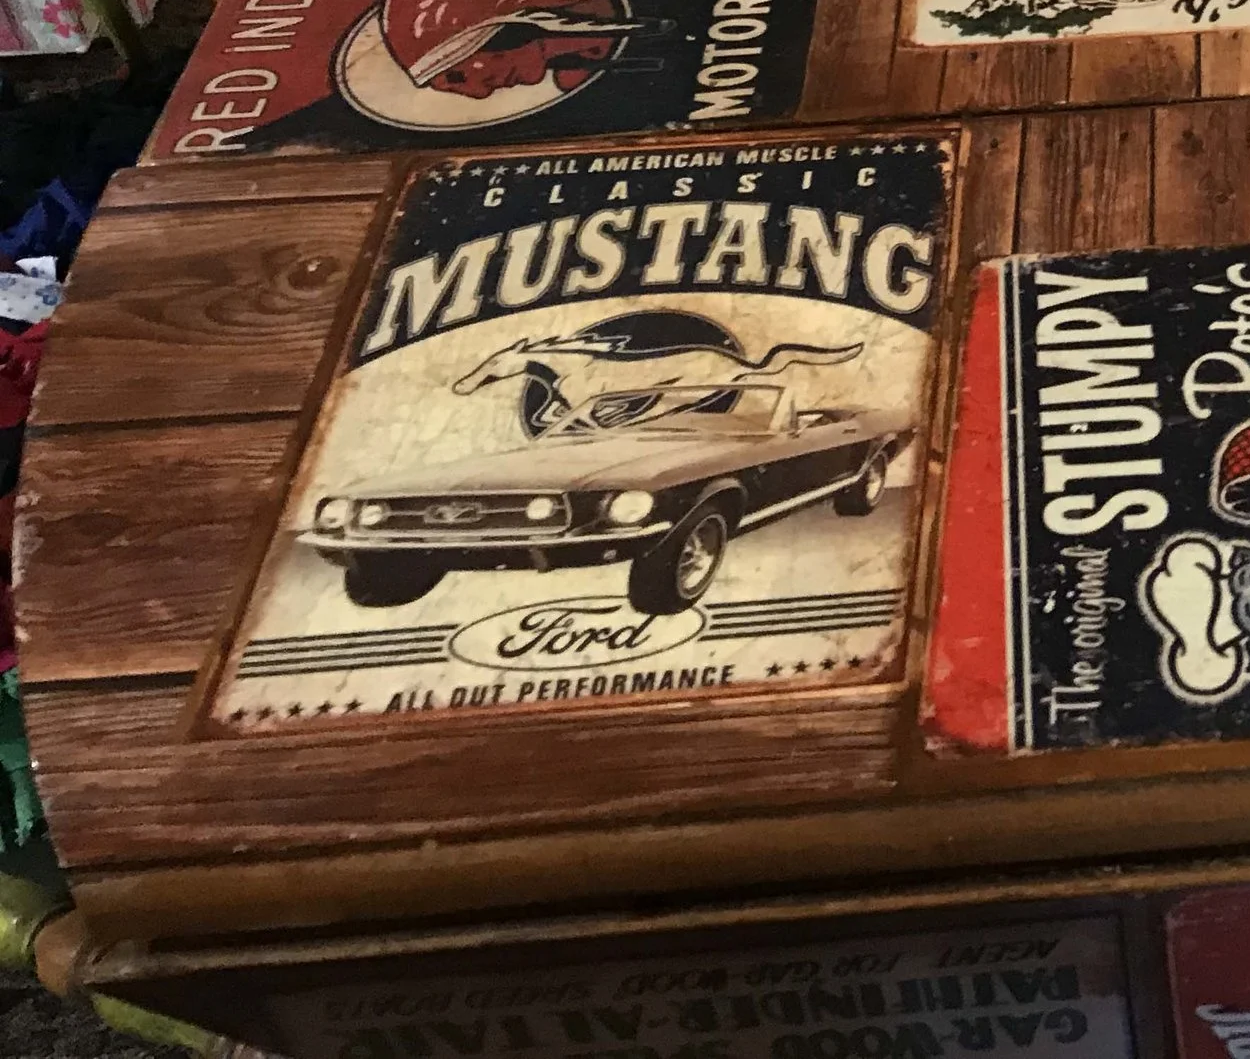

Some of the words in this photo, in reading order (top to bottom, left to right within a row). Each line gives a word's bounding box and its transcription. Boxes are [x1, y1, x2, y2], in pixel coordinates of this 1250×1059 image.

[174, 68, 281, 154] RED
[483, 165, 877, 208] CLASSIC
[536, 156, 580, 177] ALL
[588, 149, 725, 173] AMERICAN
[735, 144, 838, 165] MUSCLE
[360, 200, 935, 358] MUSTANG
[1034, 270, 1170, 536] STUMPY
[497, 606, 652, 658] Ford
[1061, 544, 1126, 649] original
[382, 688, 438, 713] ALL
[448, 684, 504, 709] OUT
[517, 663, 736, 703] PERFORMANCE
[1042, 650, 1106, 725] The
